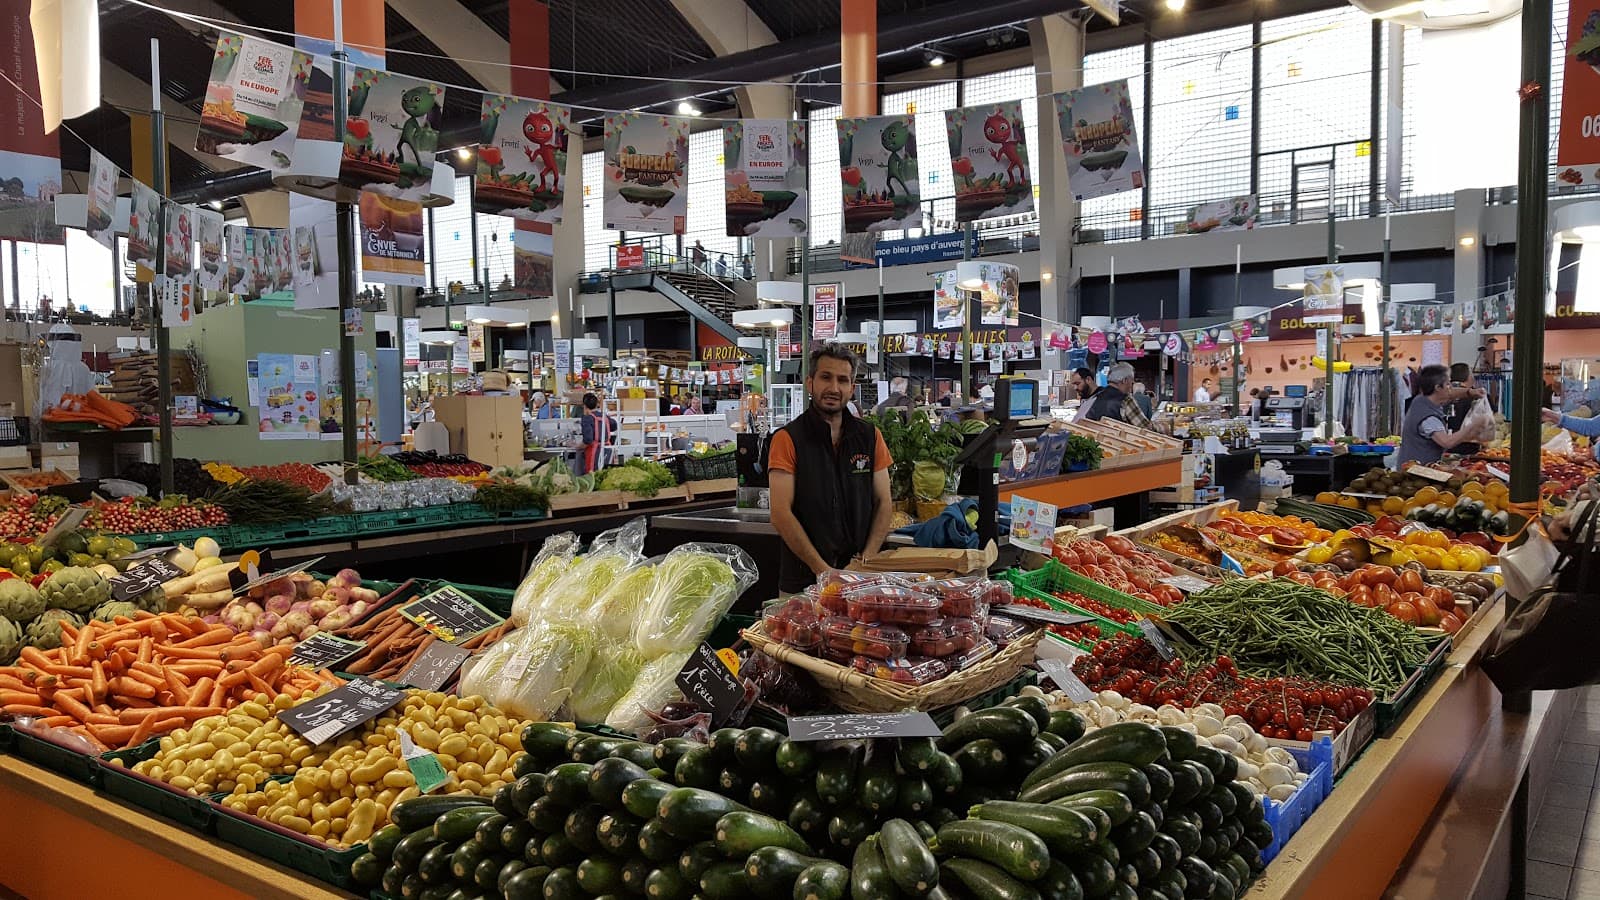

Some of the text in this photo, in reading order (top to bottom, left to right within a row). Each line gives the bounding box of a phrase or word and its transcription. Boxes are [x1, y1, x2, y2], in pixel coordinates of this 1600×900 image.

[239, 79, 280, 96] EN EUROPE
[619, 153, 675, 172] EUROPEAN
[638, 172, 671, 181] FANTASY
[875, 238, 976, 257] nce bleu pays d'auverge
[702, 346, 713, 361] LA
[698, 668, 709, 683] €
[807, 721, 837, 736] 2
